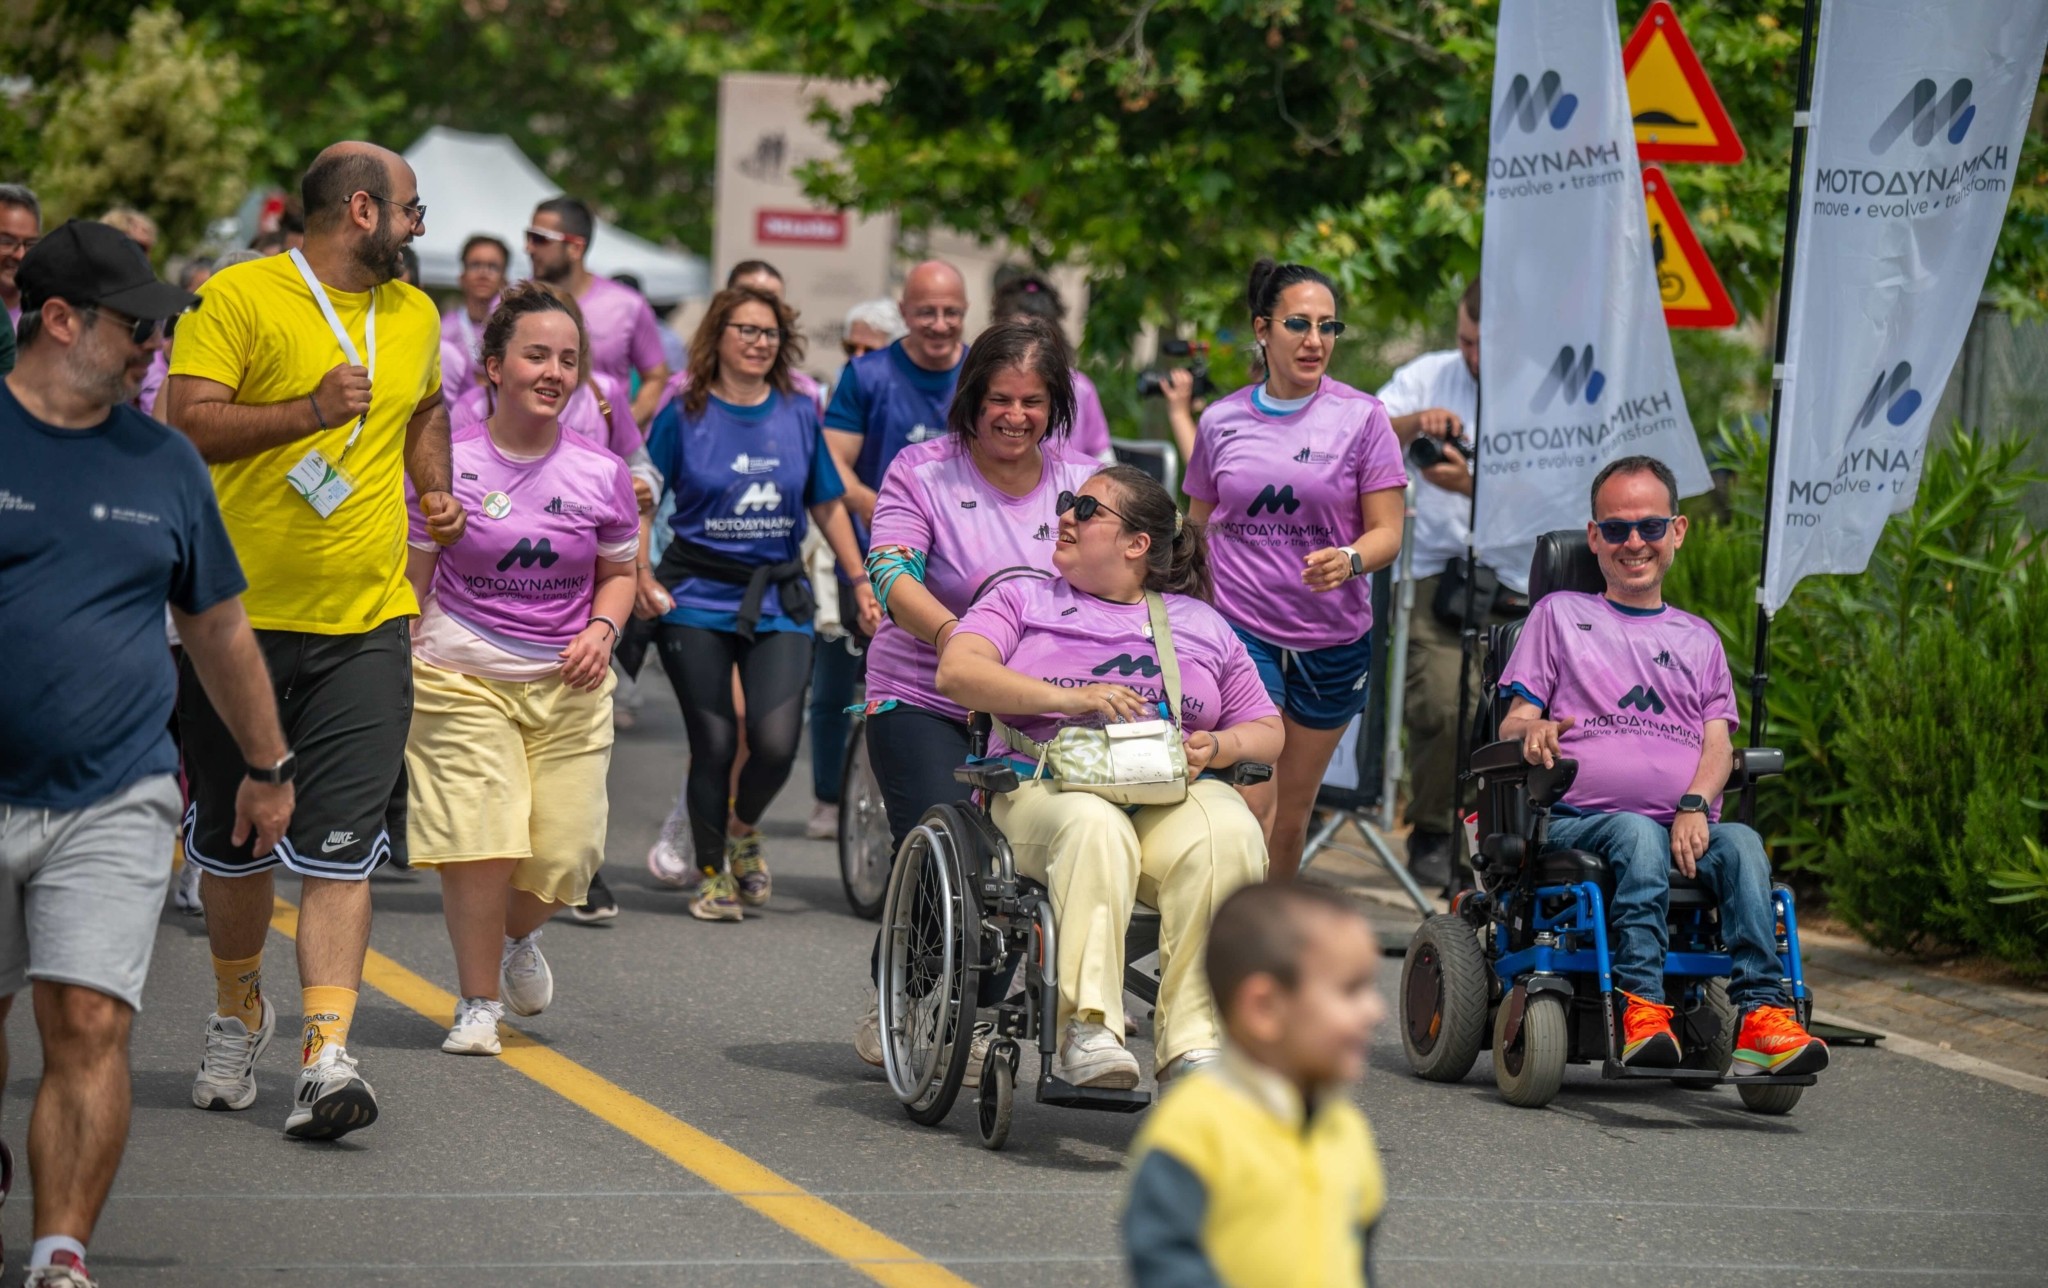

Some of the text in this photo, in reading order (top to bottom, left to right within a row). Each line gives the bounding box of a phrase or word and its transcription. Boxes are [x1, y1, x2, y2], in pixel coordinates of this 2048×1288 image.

[1498, 180, 1553, 200] evolve
[1814, 175, 2006, 218] move evolve transform
[1537, 452, 1585, 470] evolve
[1600, 417, 1677, 457] transform
[1250, 536, 1282, 547] evolve
[542, 588, 578, 600] transfo
[1583, 727, 1612, 738] move
[1621, 726, 1654, 737] evolve
[327, 830, 354, 843] NIKE
